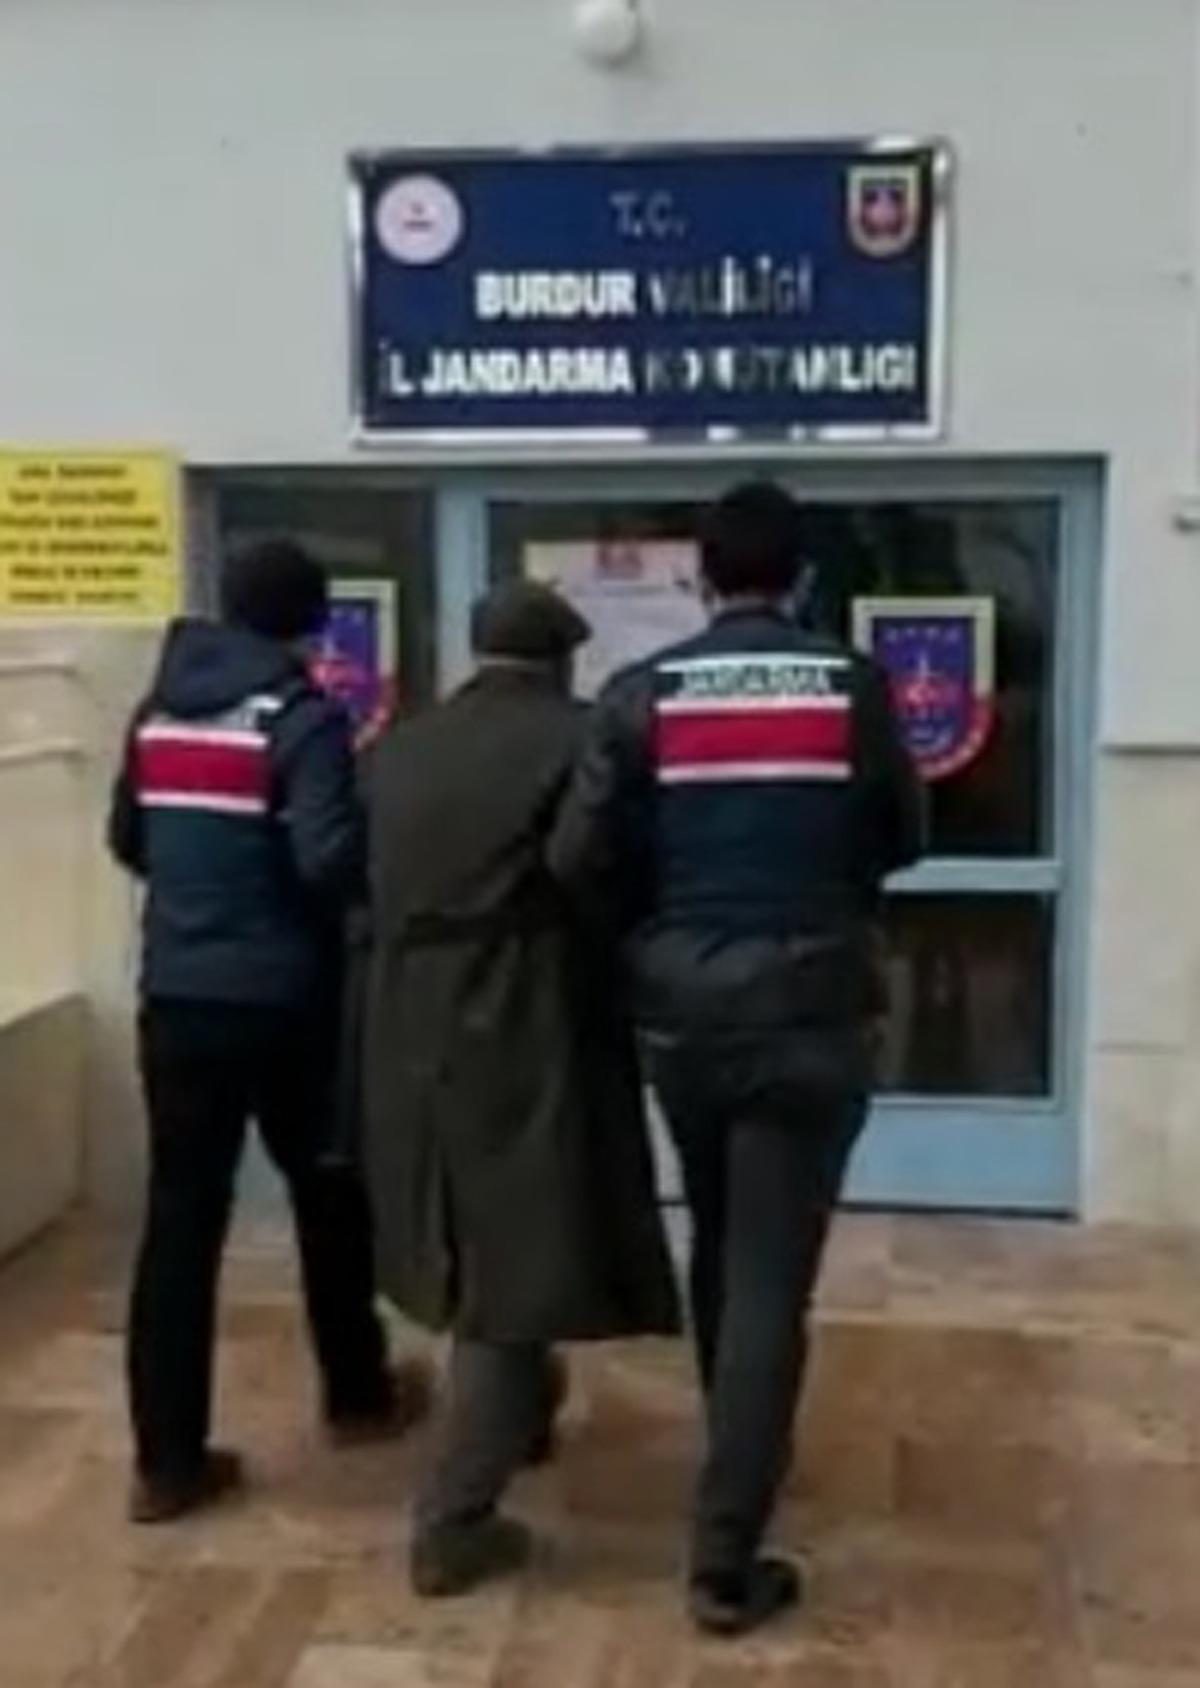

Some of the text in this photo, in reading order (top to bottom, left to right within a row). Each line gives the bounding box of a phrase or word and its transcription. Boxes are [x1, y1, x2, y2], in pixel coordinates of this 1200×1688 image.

[608, 189, 686, 237] T.C.
[474, 269, 637, 318] BURDUR
[421, 347, 634, 394] JANDARMA
